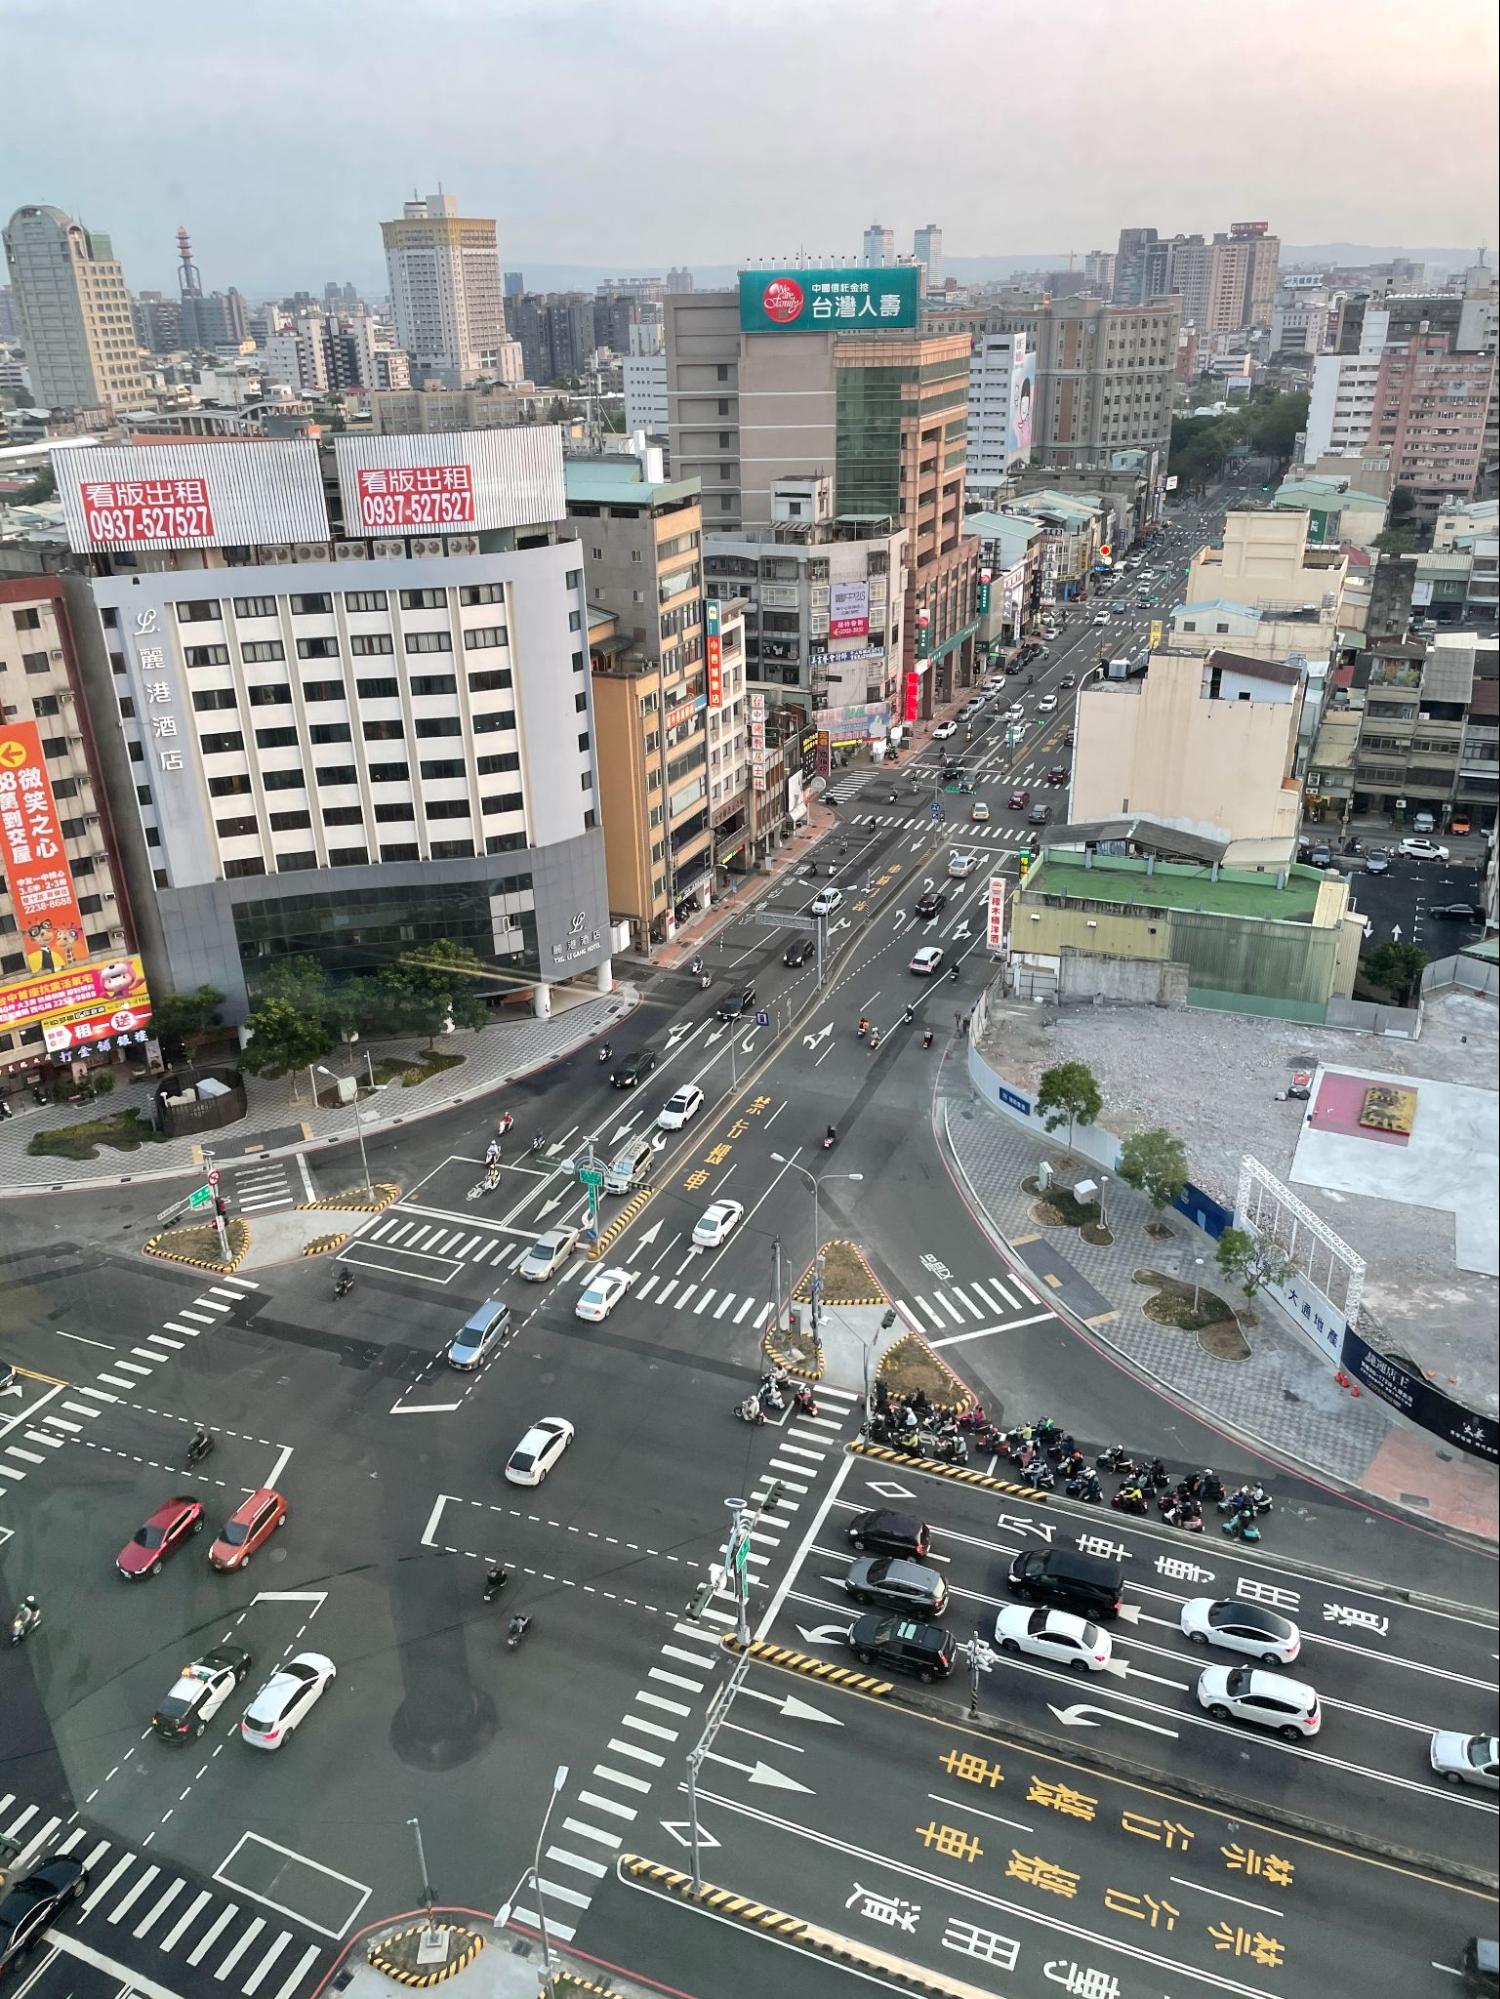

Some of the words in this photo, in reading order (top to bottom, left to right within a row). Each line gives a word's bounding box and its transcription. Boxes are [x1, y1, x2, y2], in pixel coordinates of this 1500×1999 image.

[812, 283, 869, 293] 中國信託金控
[812, 294, 901, 319] 台灣人壽
[85, 480, 205, 508] 看版出租
[362, 467, 470, 494] 看版出租
[363, 491, 472, 525] 0937-527527
[89, 505, 208, 540] 0937-527527
[139, 646, 184, 771] 麗港酒店
[17, 766, 59, 859] 微笑之心
[683, 1095, 772, 1191] 禁行機車
[1288, 1288, 1338, 1348] 大通地產
[997, 1513, 1389, 1637] 公車專用道
[939, 1749, 1296, 1887] 禁行機車
[915, 1821, 1286, 1968] 禁行機車
